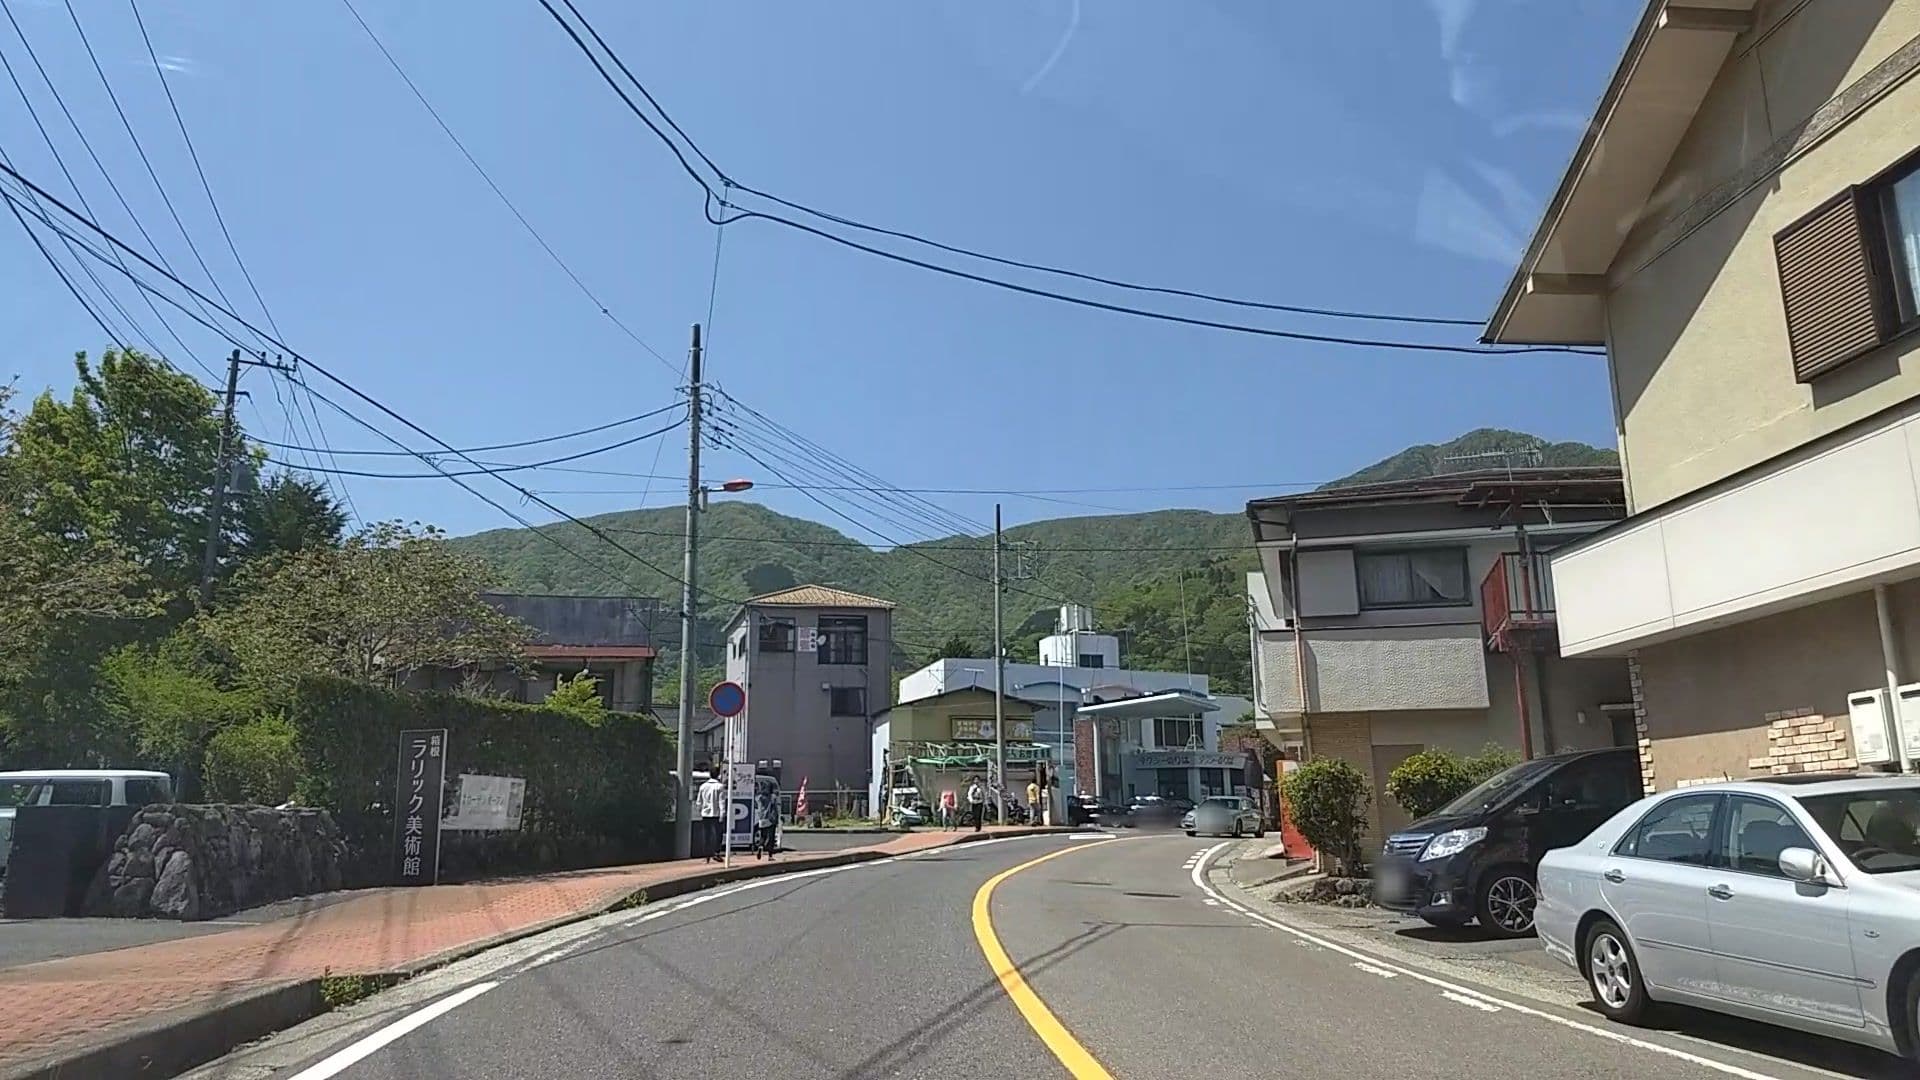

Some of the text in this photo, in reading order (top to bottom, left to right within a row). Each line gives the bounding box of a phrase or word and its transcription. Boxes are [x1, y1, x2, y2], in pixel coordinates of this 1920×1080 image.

[430, 735, 441, 757] 箱根
[403, 739, 427, 876] ラリック美術館
[731, 802, 749, 831] P
